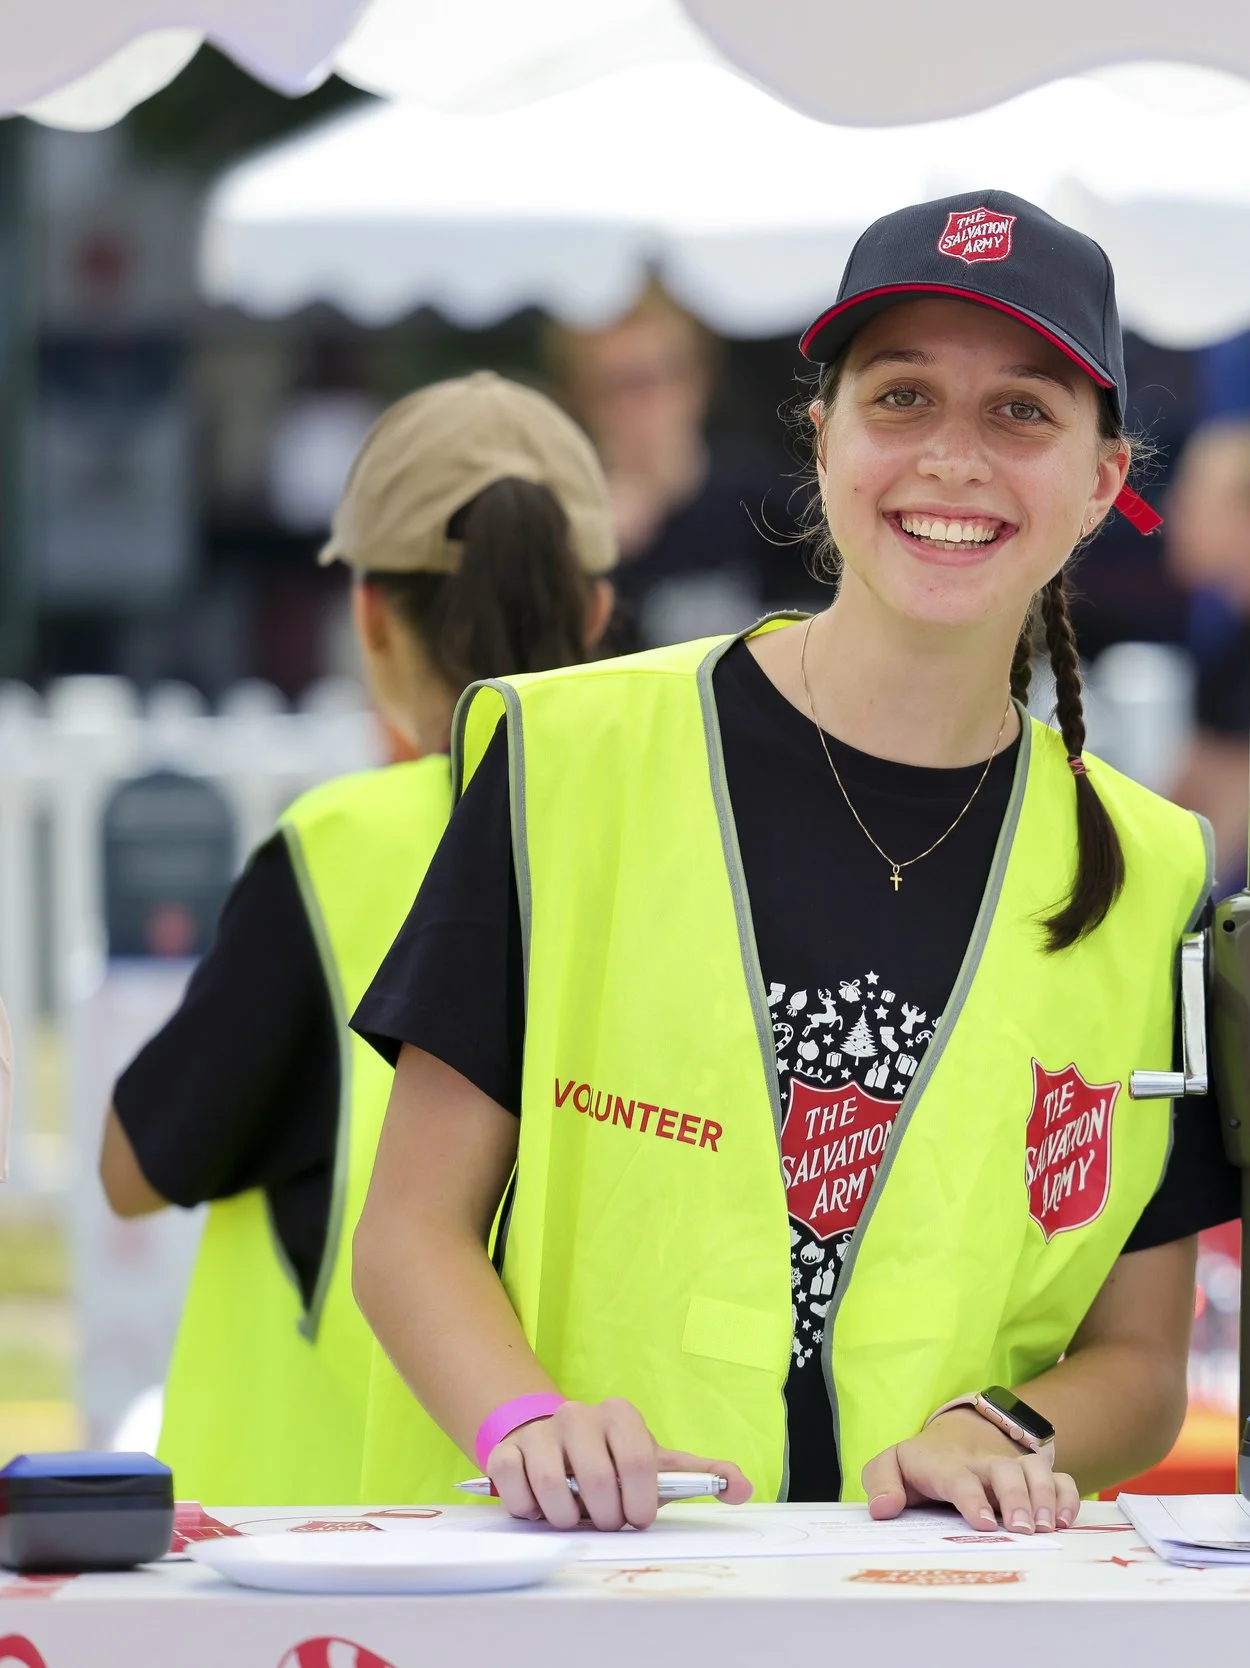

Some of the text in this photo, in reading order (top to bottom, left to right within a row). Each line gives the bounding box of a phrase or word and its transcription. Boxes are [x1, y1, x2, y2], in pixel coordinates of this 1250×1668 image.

[942, 218, 1008, 249] SALVATION
[956, 211, 986, 230] THE
[961, 236, 1004, 256] ARMY
[555, 1077, 723, 1153] VOLUNTEER
[805, 1096, 858, 1141] THE
